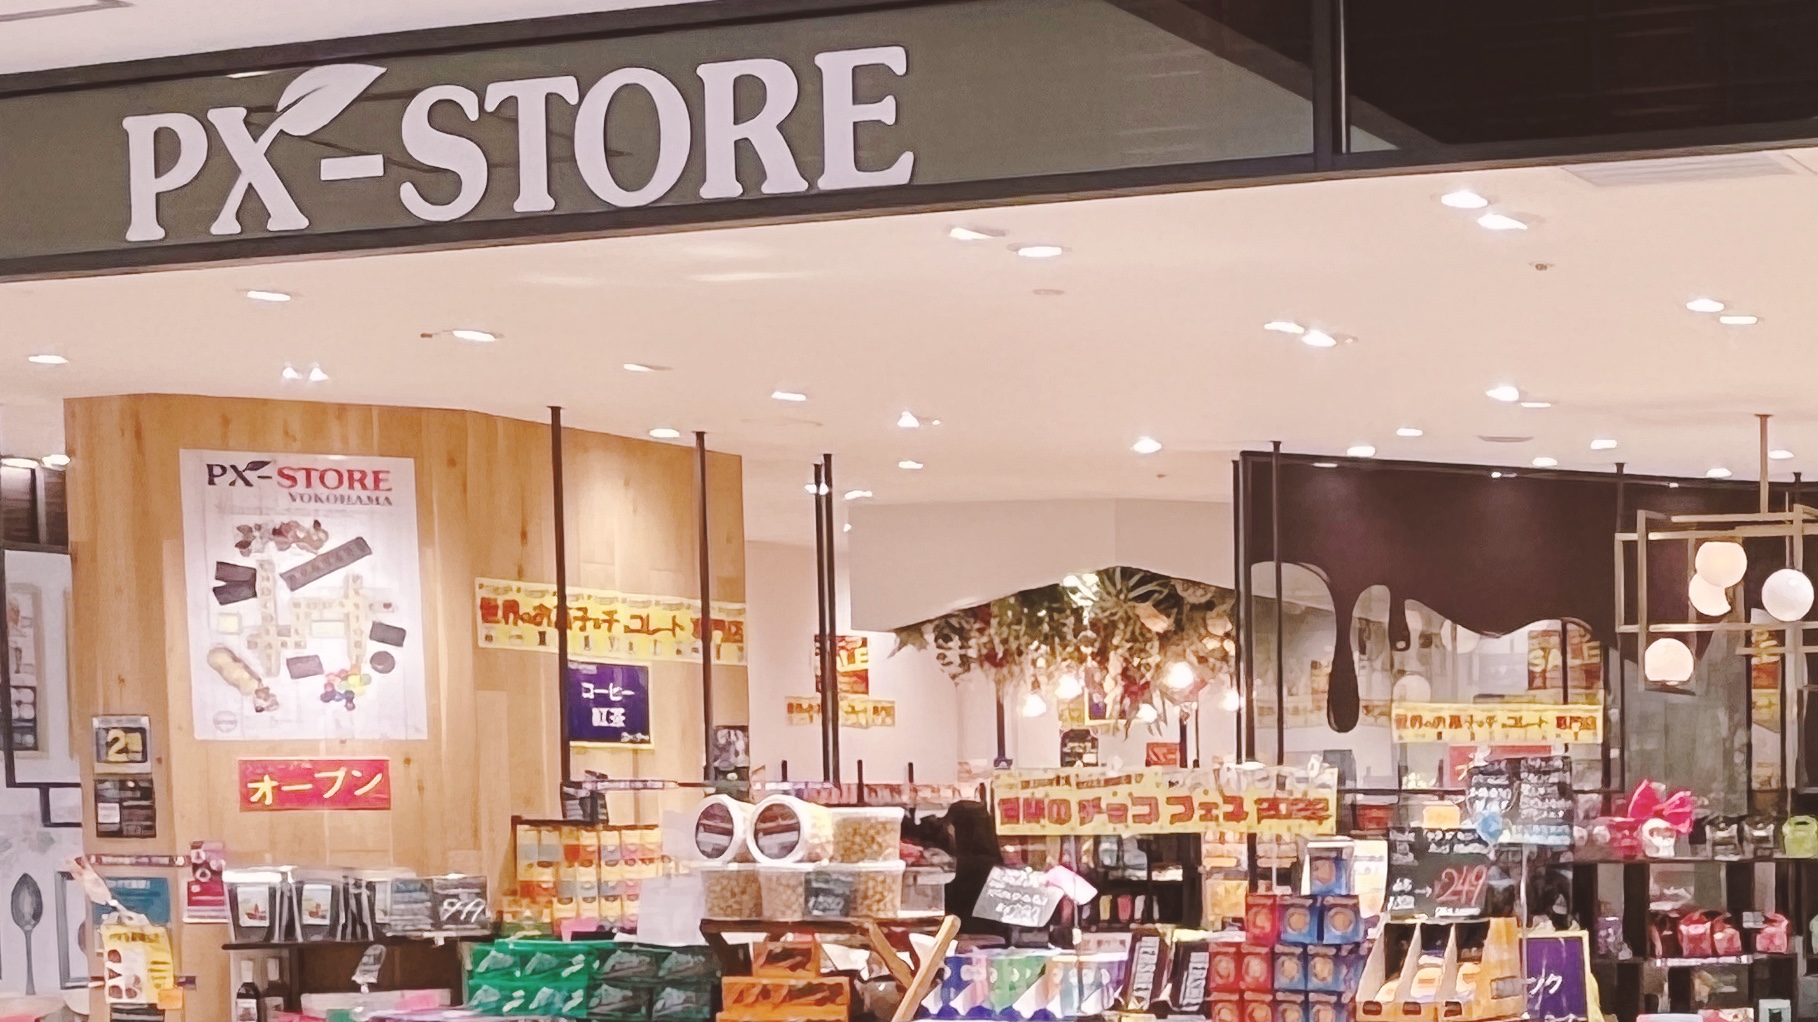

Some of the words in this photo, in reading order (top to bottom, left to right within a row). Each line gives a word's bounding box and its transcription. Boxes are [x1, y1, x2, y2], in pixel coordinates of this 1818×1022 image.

[121, 45, 915, 242] PX-STORE
[206, 460, 392, 491] PX-STORE
[581, 682, 635, 700] コーヒー
